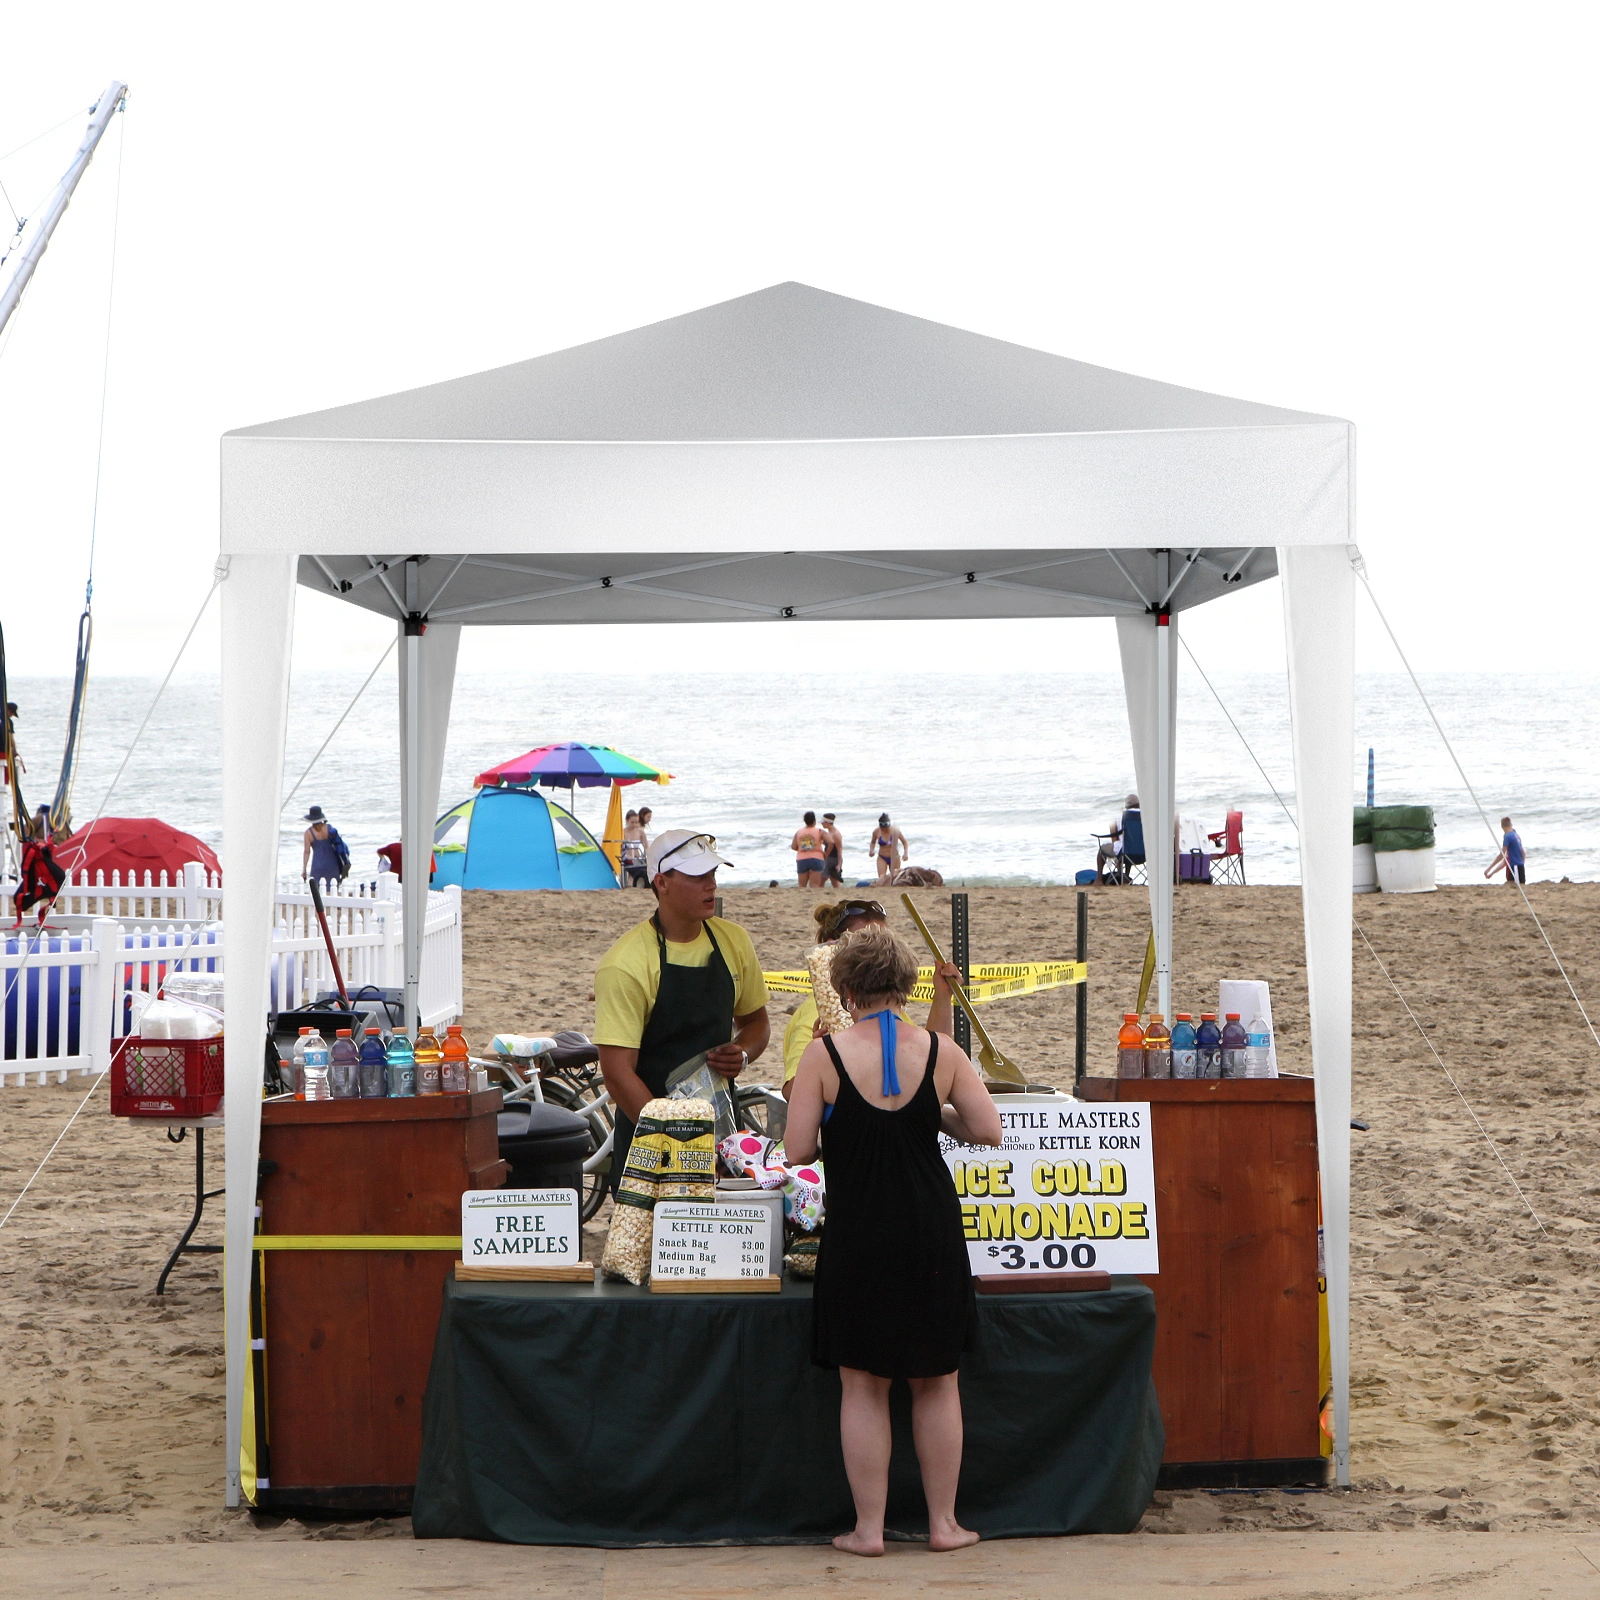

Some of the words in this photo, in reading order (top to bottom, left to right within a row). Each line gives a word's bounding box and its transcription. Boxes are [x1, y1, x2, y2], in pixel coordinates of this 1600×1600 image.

[424, 1070, 439, 1080] G2
[1000, 1112, 1048, 1129] ETTLE
[1058, 1112, 1140, 1129] MASTERS
[1003, 1135, 1020, 1143] OLD
[1039, 1136, 1092, 1150] KETTLE
[1098, 1135, 1141, 1150] KORN
[682, 1160, 711, 1170] KORN
[953, 1158, 1015, 1197] ICE
[1031, 1158, 1128, 1197] COLD
[496, 1194, 527, 1203] KETTLE
[531, 1193, 571, 1202] MASTERS
[689, 1207, 720, 1216] KETTLE
[724, 1208, 764, 1218] MASTERS
[495, 1215, 546, 1233] FREE
[961, 1202, 1150, 1241] EMONADE
[671, 1222, 714, 1233] KETTLE
[720, 1224, 754, 1235] KORN
[473, 1236, 569, 1256] SAMPLES
[659, 1238, 687, 1247] Snack
[691, 1239, 709, 1250] Bag
[741, 1241, 765, 1250] $3.00
[658, 1251, 695, 1261] Medium
[699, 1252, 716, 1263] Bag
[741, 1254, 764, 1263] $5.00
[987, 1243, 1097, 1270] $3.00
[658, 1264, 685, 1275] Large
[689, 1266, 706, 1277] Bag
[740, 1268, 763, 1277] $8.00
